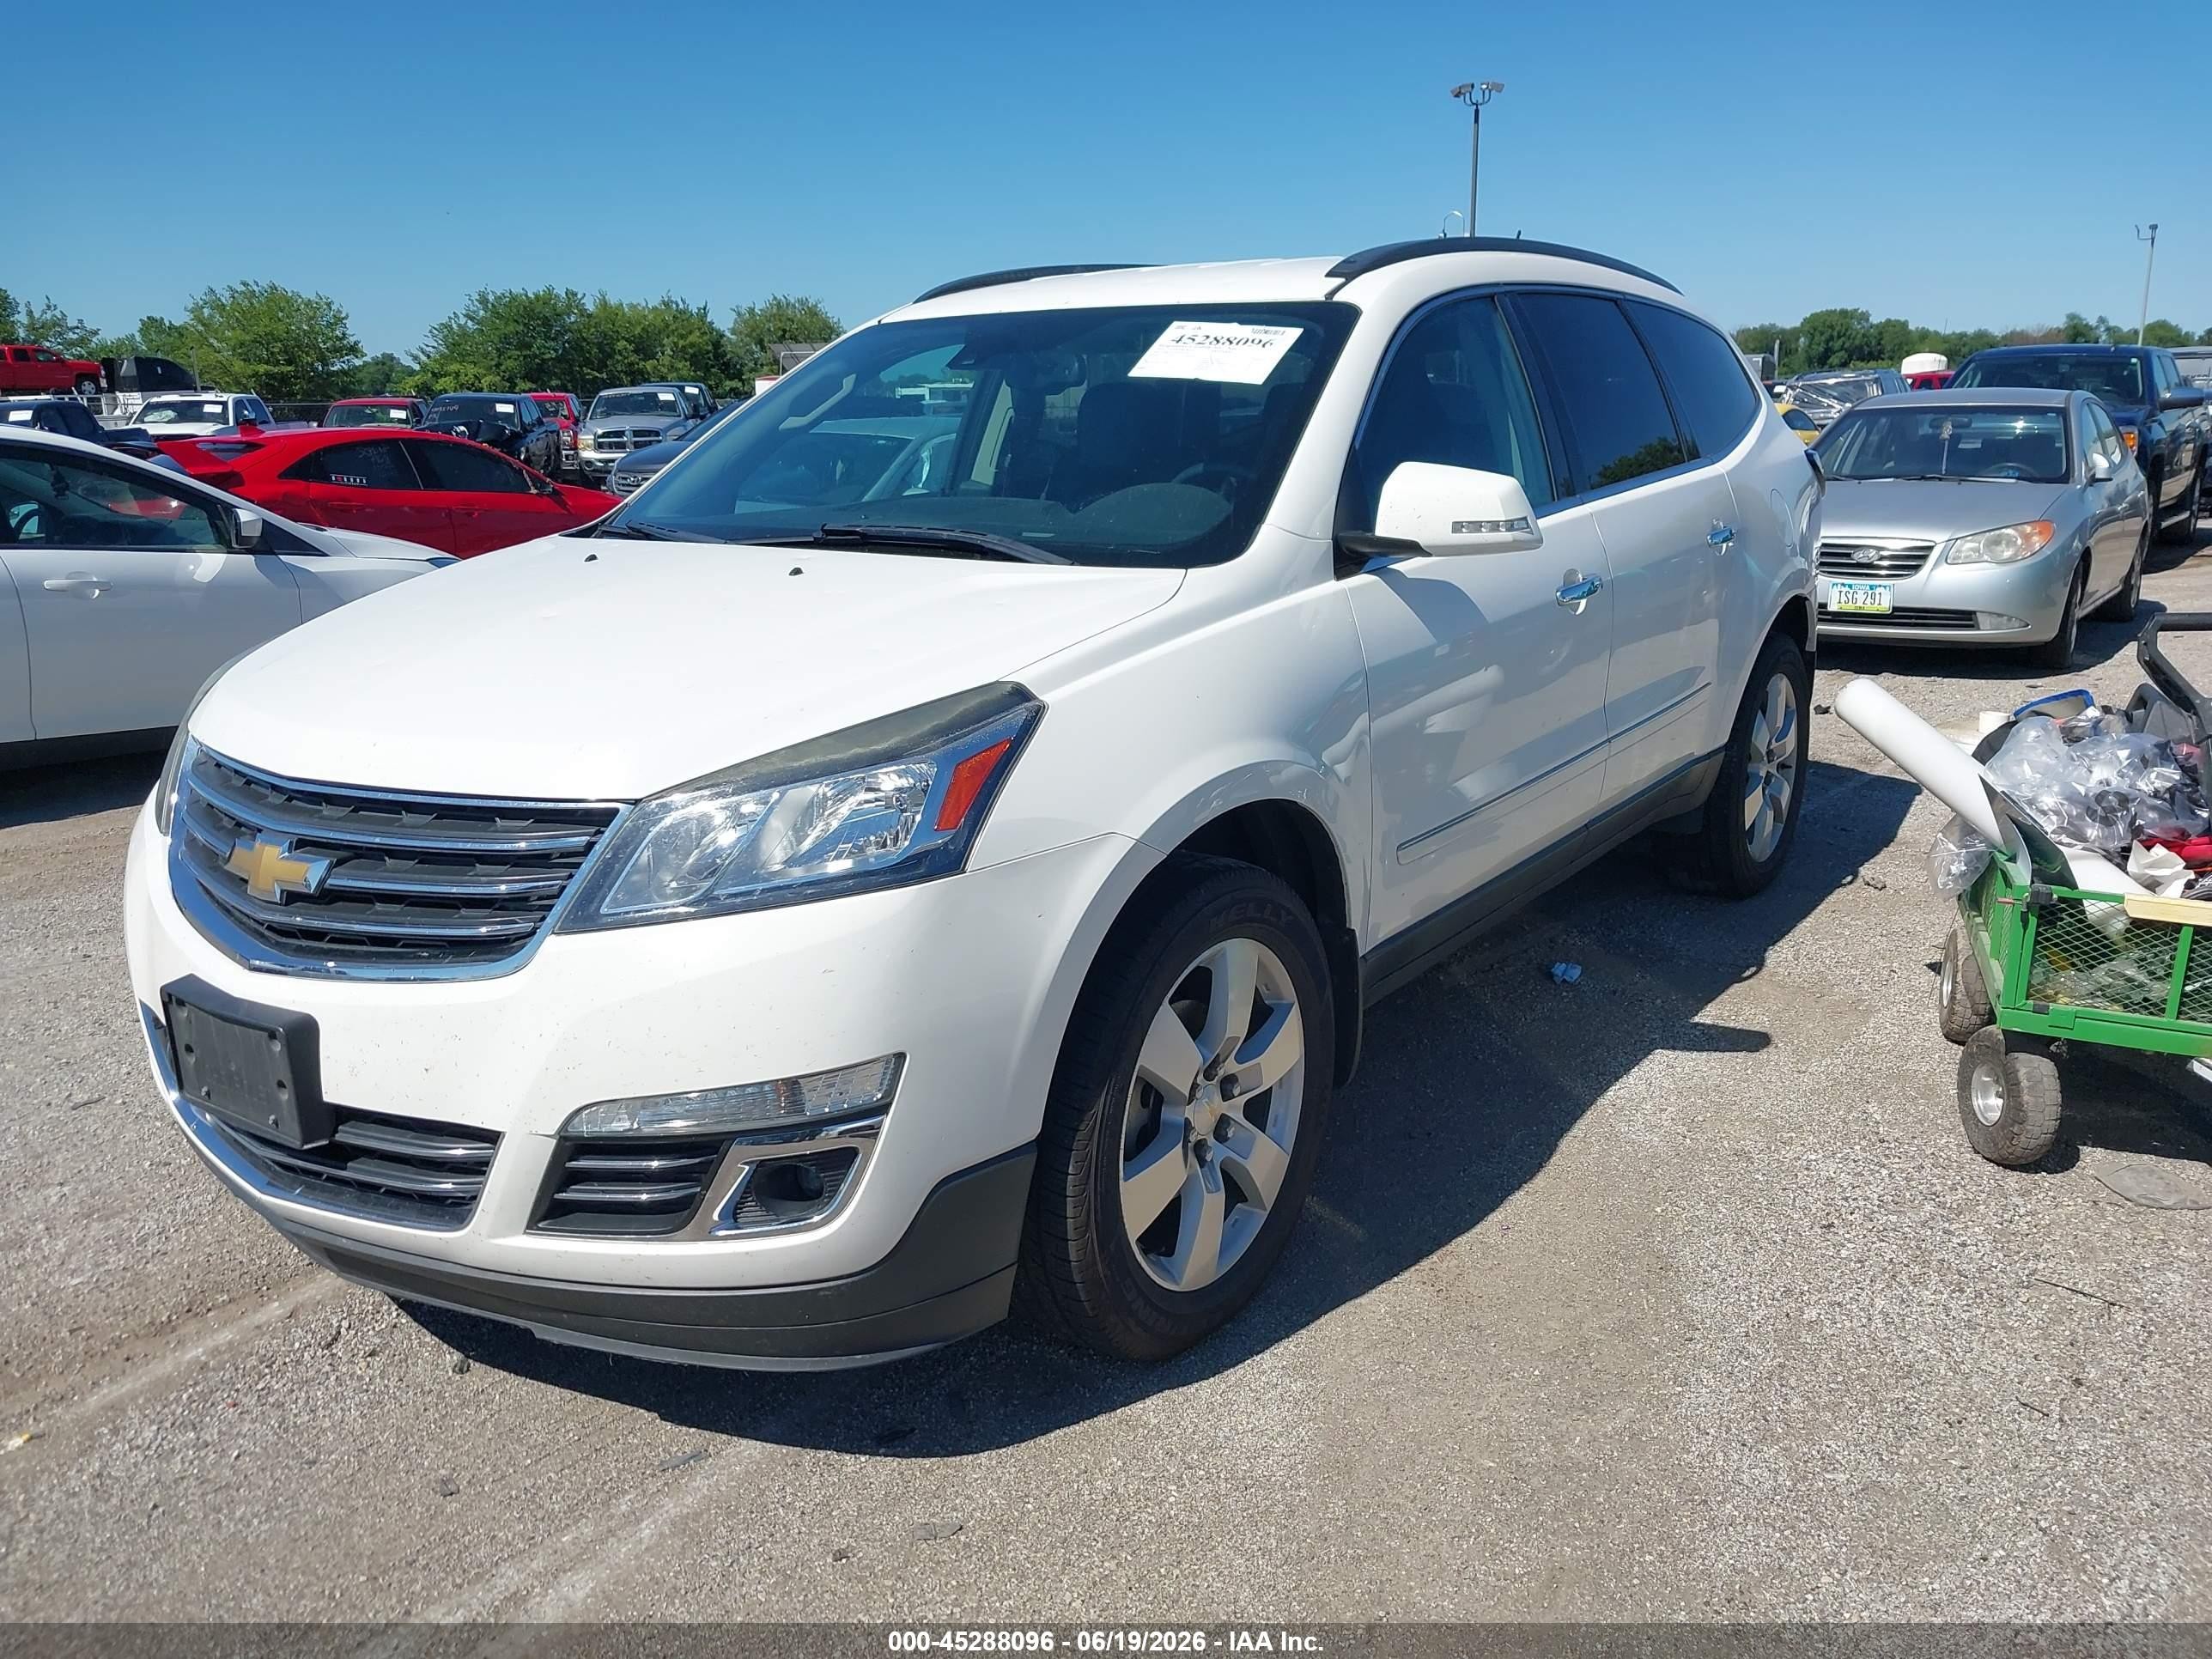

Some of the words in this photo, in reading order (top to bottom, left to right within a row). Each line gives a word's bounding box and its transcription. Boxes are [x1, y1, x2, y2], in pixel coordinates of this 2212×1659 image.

[1171, 334, 1273, 348] 45288096
[1838, 590, 1858, 605] ISG
[1863, 591, 1882, 605] 291
